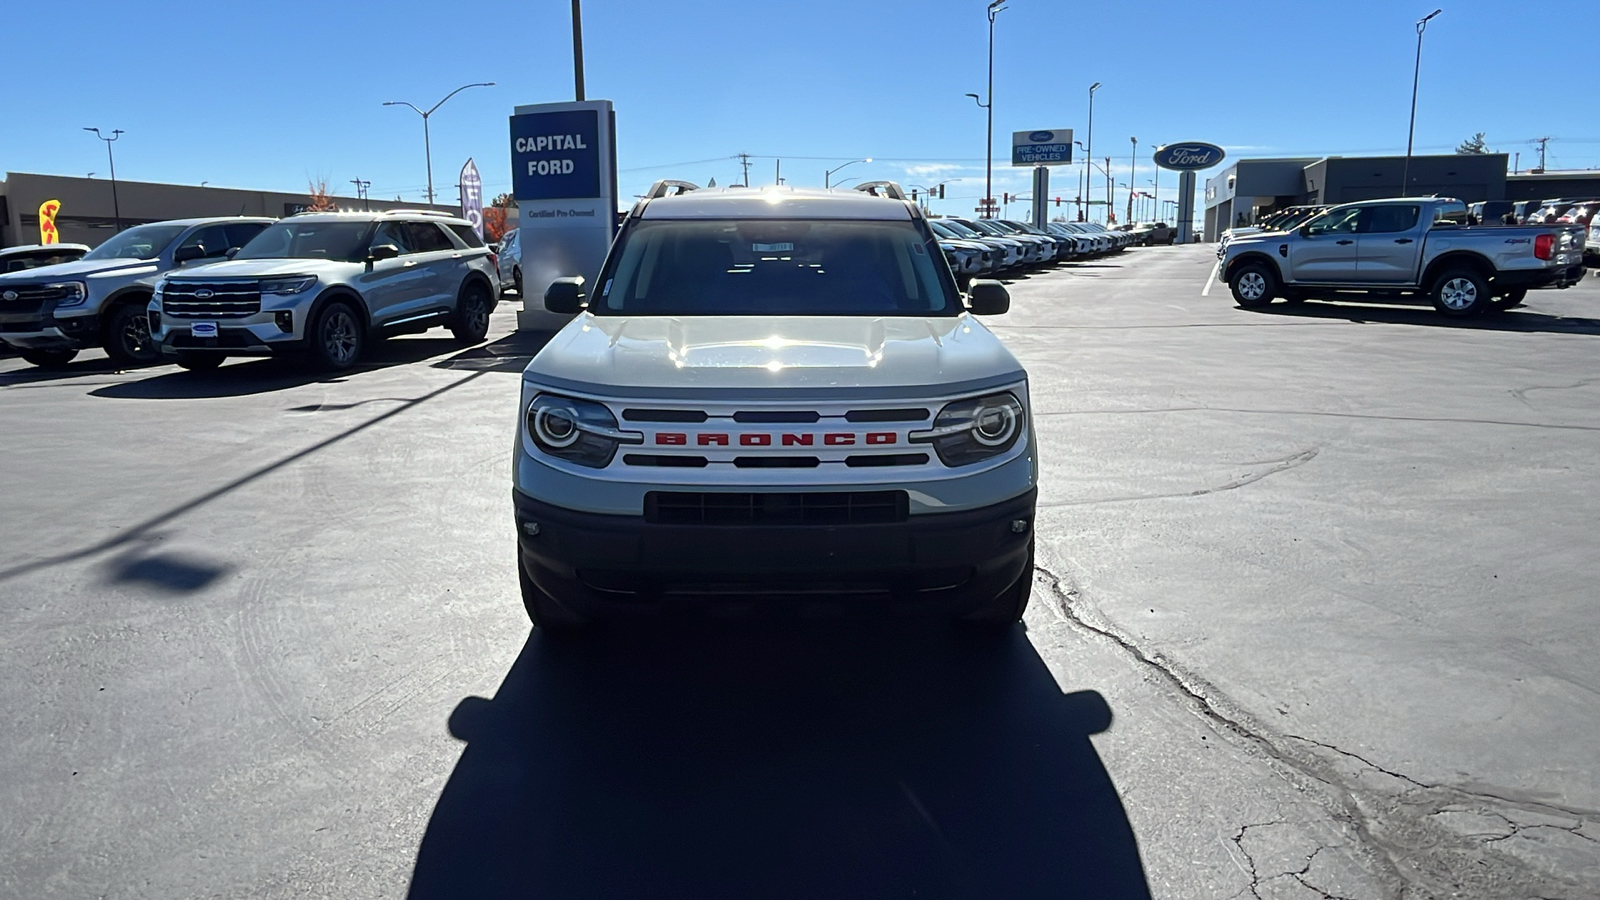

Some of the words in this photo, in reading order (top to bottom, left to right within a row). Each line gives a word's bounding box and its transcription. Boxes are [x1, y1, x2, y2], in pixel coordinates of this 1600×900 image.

[515, 134, 587, 153] CAPITAL
[1016, 144, 1067, 154] PRE-OWNED
[1021, 152, 1061, 161] VEHICLES
[1168, 147, 1211, 164] Ford
[527, 159, 574, 176] FORD
[528, 208, 556, 218] Certified
[556, 207, 595, 218] Pre-Owned
[655, 432, 897, 446] BRONCO
